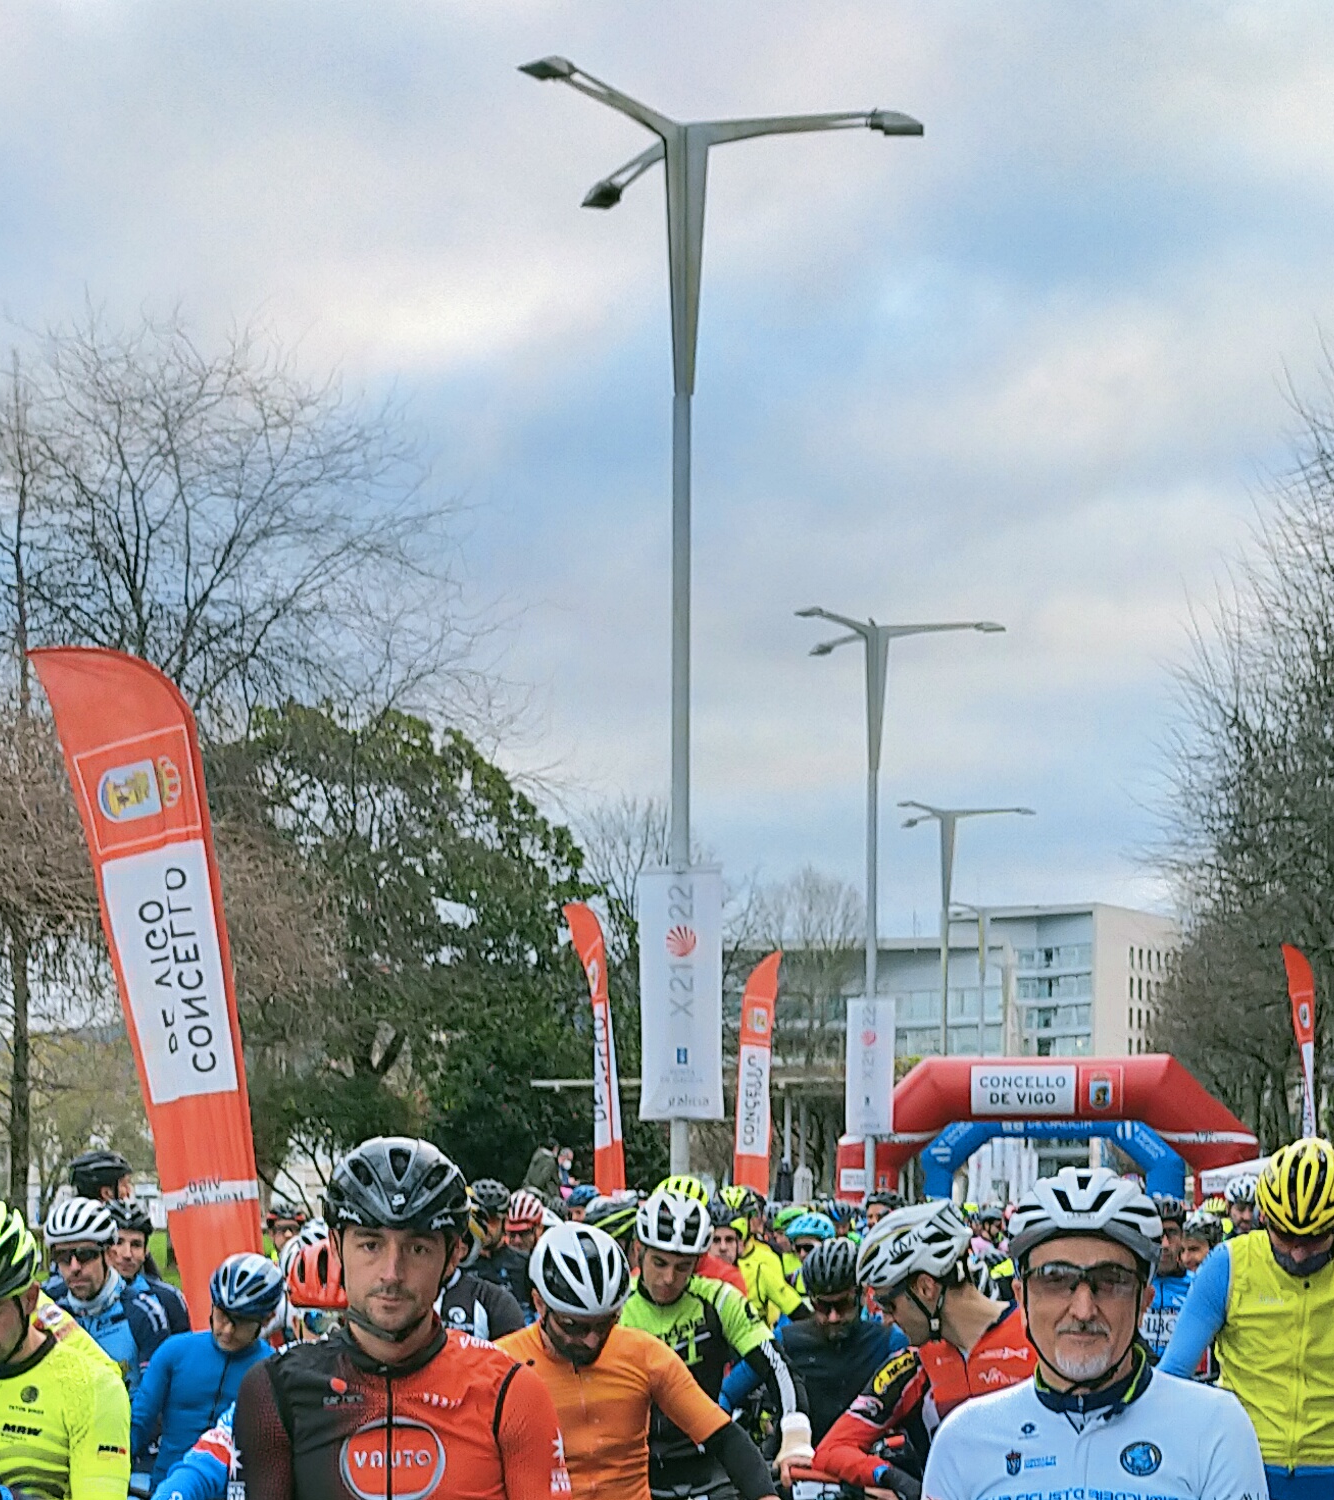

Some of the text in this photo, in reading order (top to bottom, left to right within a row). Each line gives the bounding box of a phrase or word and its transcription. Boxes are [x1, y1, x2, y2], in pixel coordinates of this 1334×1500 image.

[979, 1075, 1066, 1090] CONCELLO
[990, 1092, 1056, 1106] DE VIGO
